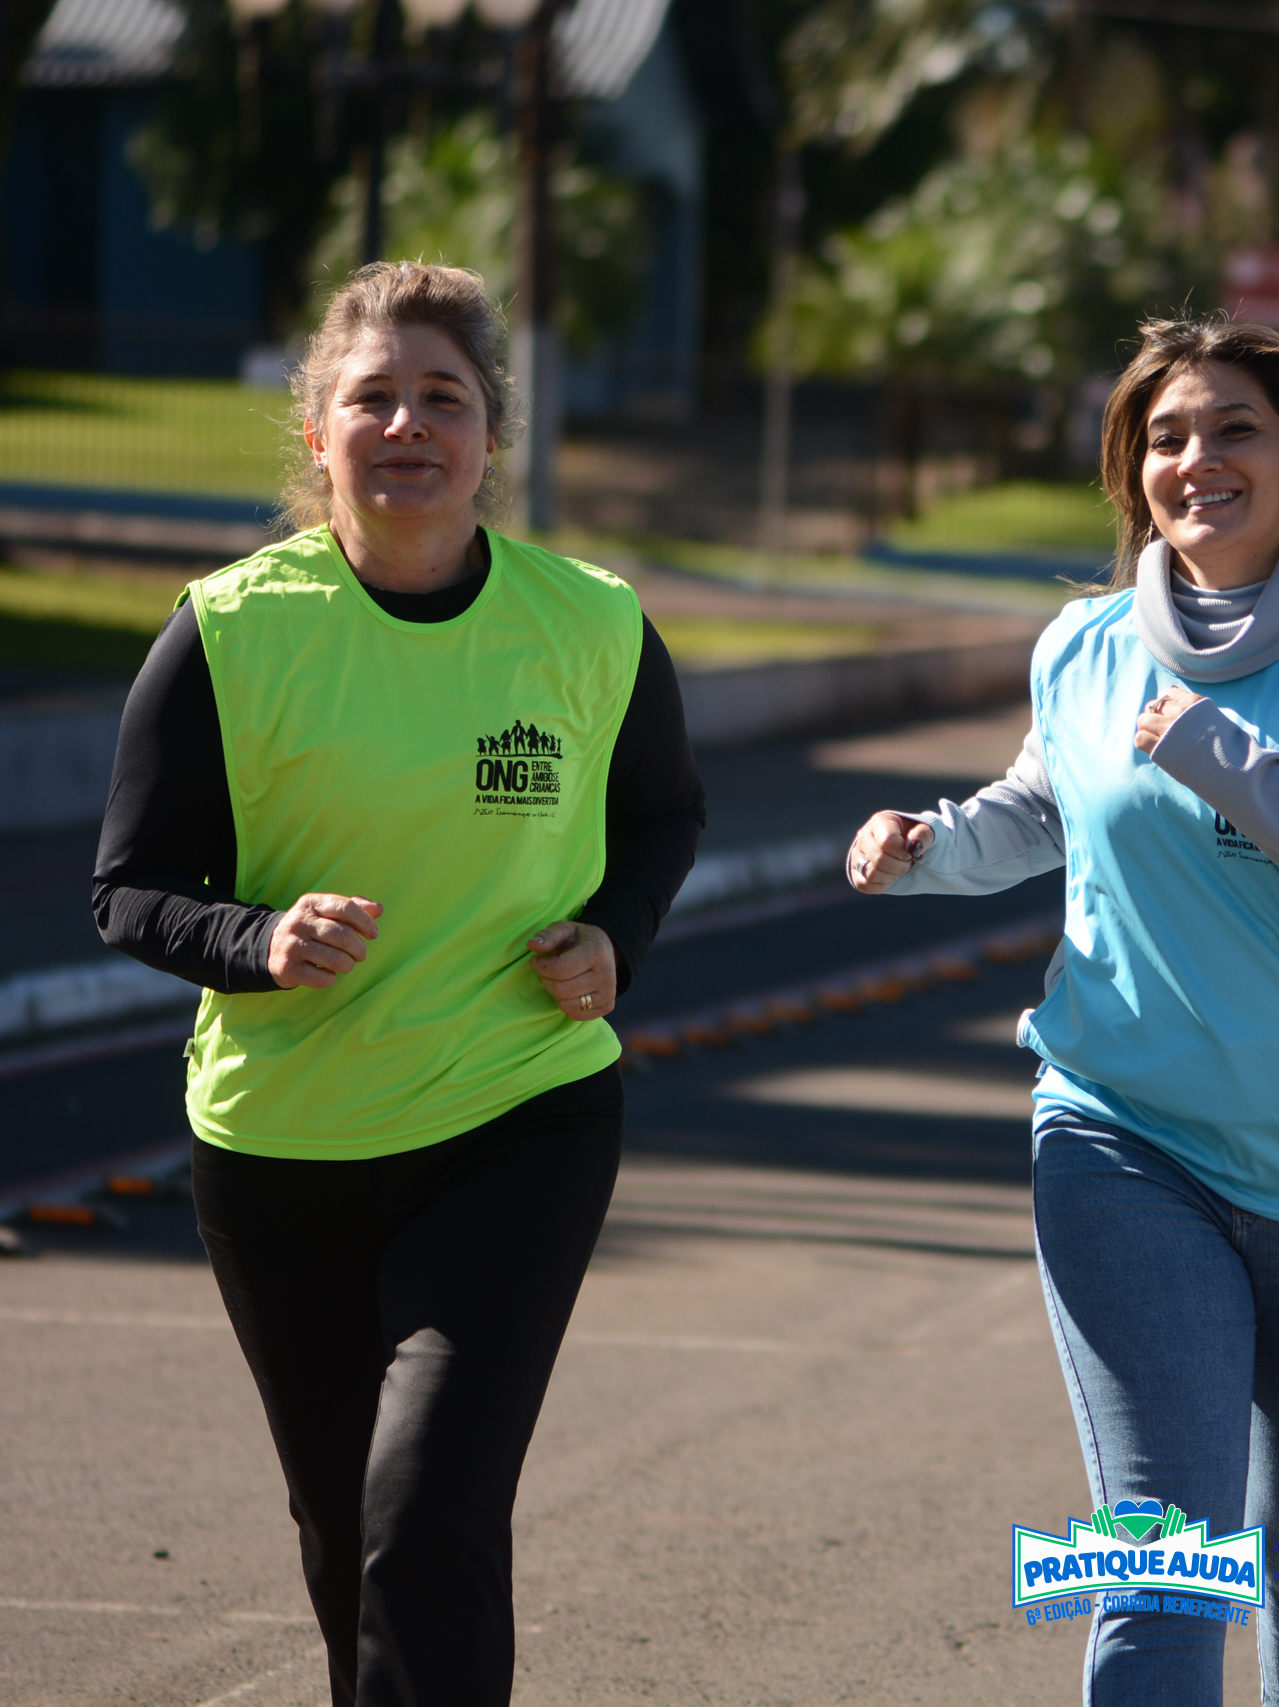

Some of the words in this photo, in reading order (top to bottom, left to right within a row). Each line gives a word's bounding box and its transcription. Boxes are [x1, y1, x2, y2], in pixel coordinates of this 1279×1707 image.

[532, 761, 553, 772] ENTRE
[476, 759, 528, 793] ONG
[475, 794, 481, 803] A
[482, 795, 499, 804] VIDA
[500, 795, 515, 805] FICA
[516, 796, 532, 805] MAIS
[533, 796, 559, 805] DIVERTIDA
[1222, 838, 1239, 848] VIDA
[1239, 841, 1254, 851] FICA
